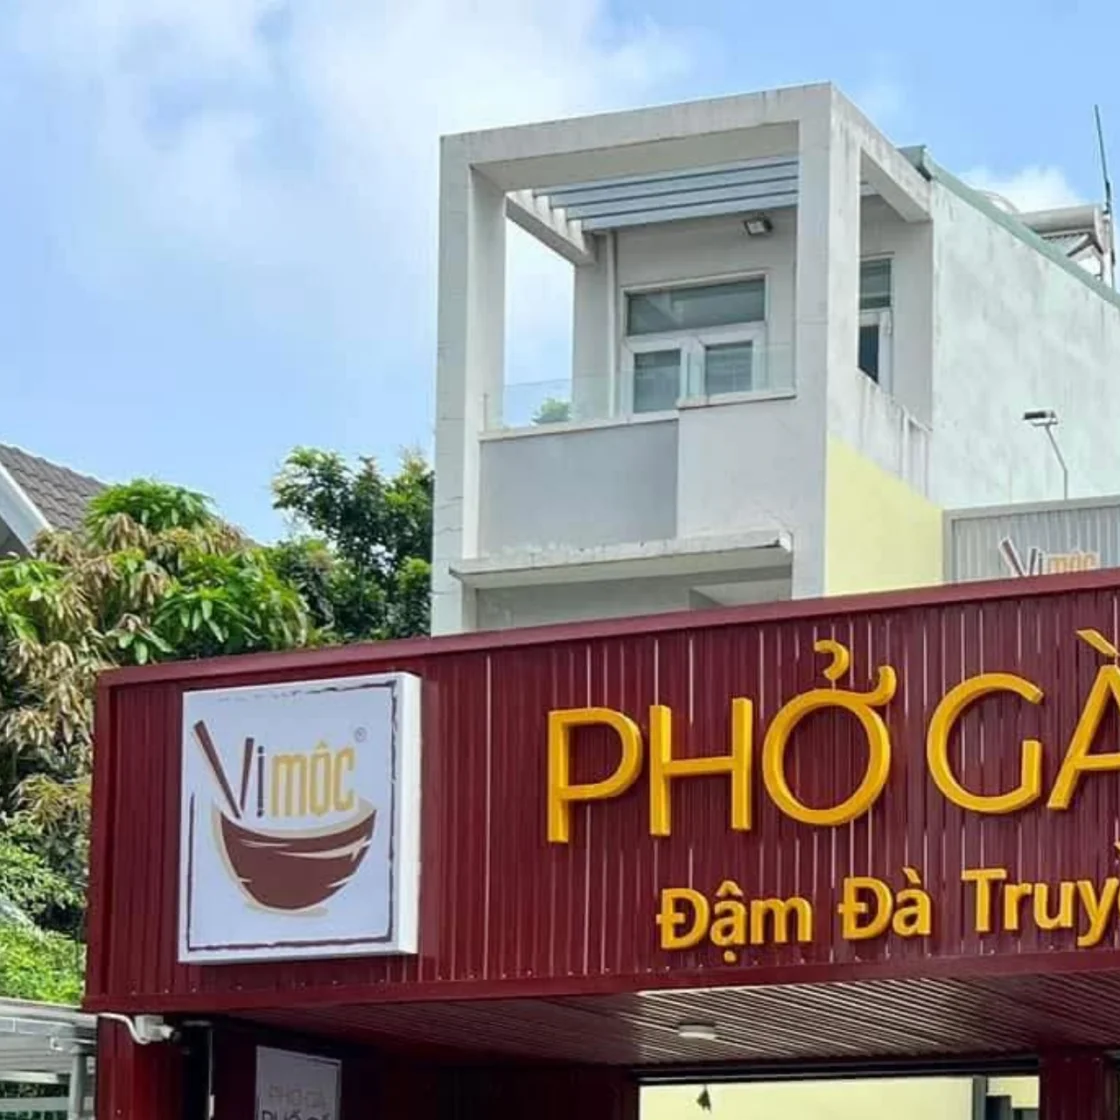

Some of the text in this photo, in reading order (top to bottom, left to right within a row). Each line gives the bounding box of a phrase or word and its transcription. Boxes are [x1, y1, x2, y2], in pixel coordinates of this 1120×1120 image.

[548, 639, 898, 844] PHỞ
[656, 880, 813, 963] Đậm
[838, 867, 932, 941] Đà
